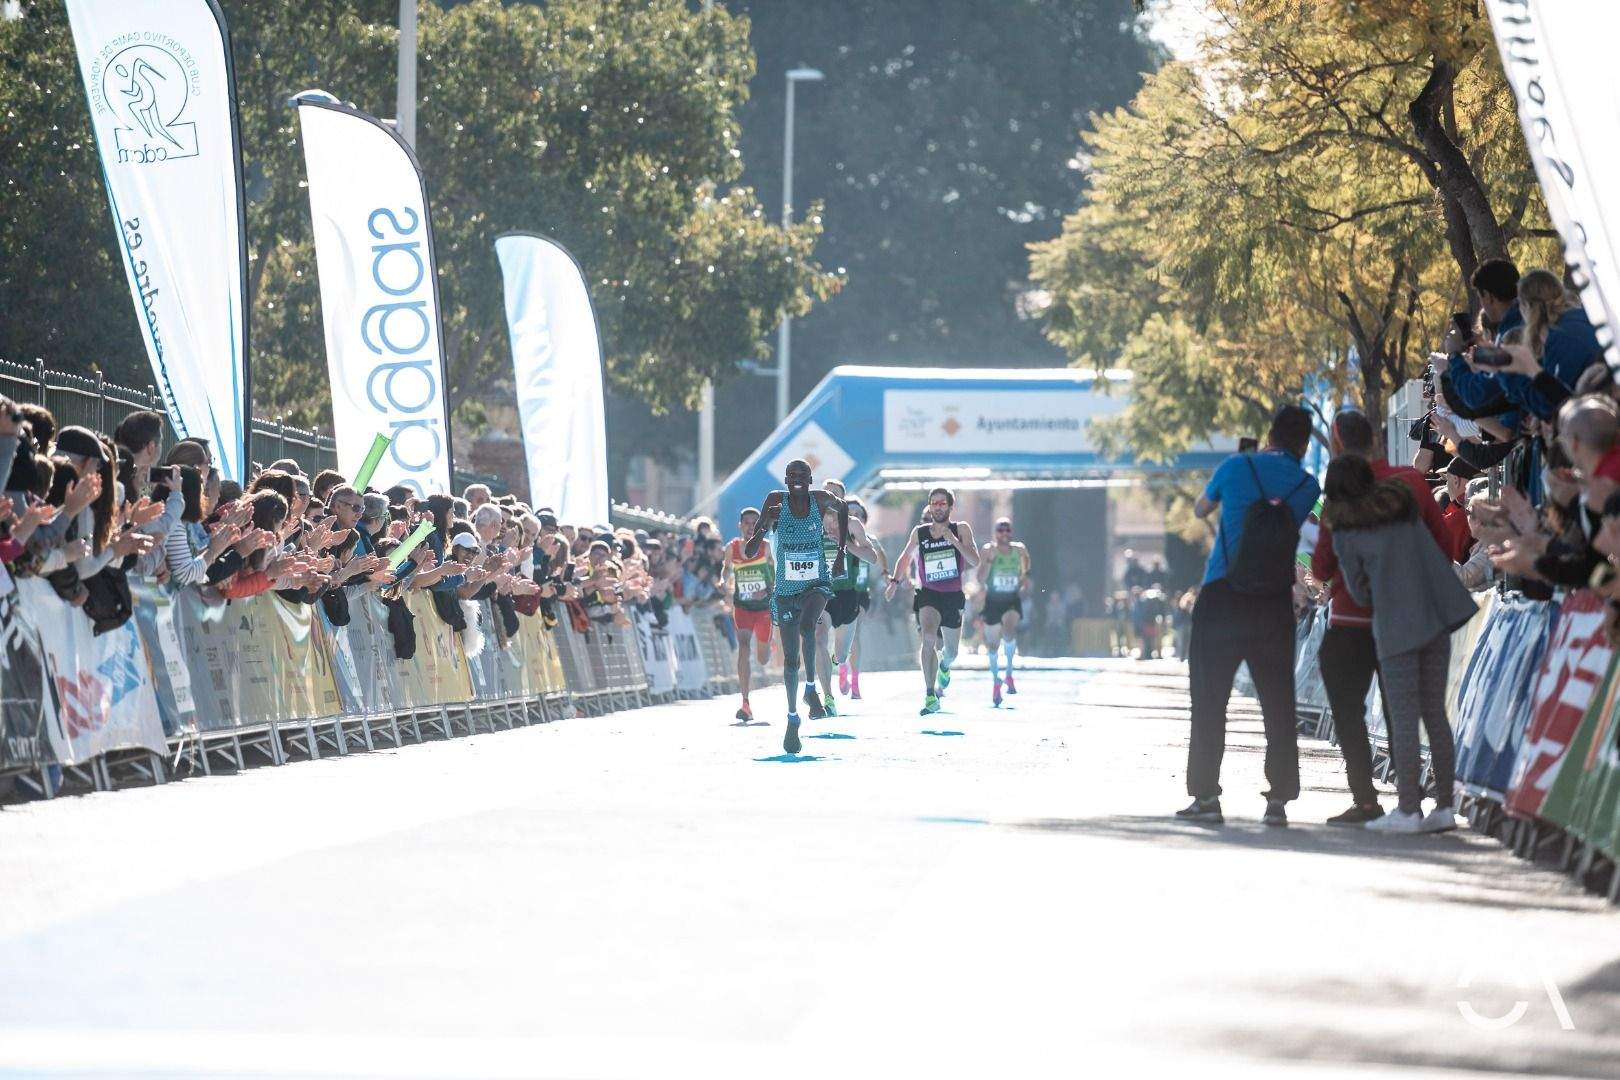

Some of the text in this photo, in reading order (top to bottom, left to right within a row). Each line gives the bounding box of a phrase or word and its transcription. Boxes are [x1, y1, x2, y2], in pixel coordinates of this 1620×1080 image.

[976, 415, 1079, 433] Ayuntamiento
[789, 561, 814, 571] 1849
[936, 560, 945, 571] 4
[741, 582, 761, 593] 100
